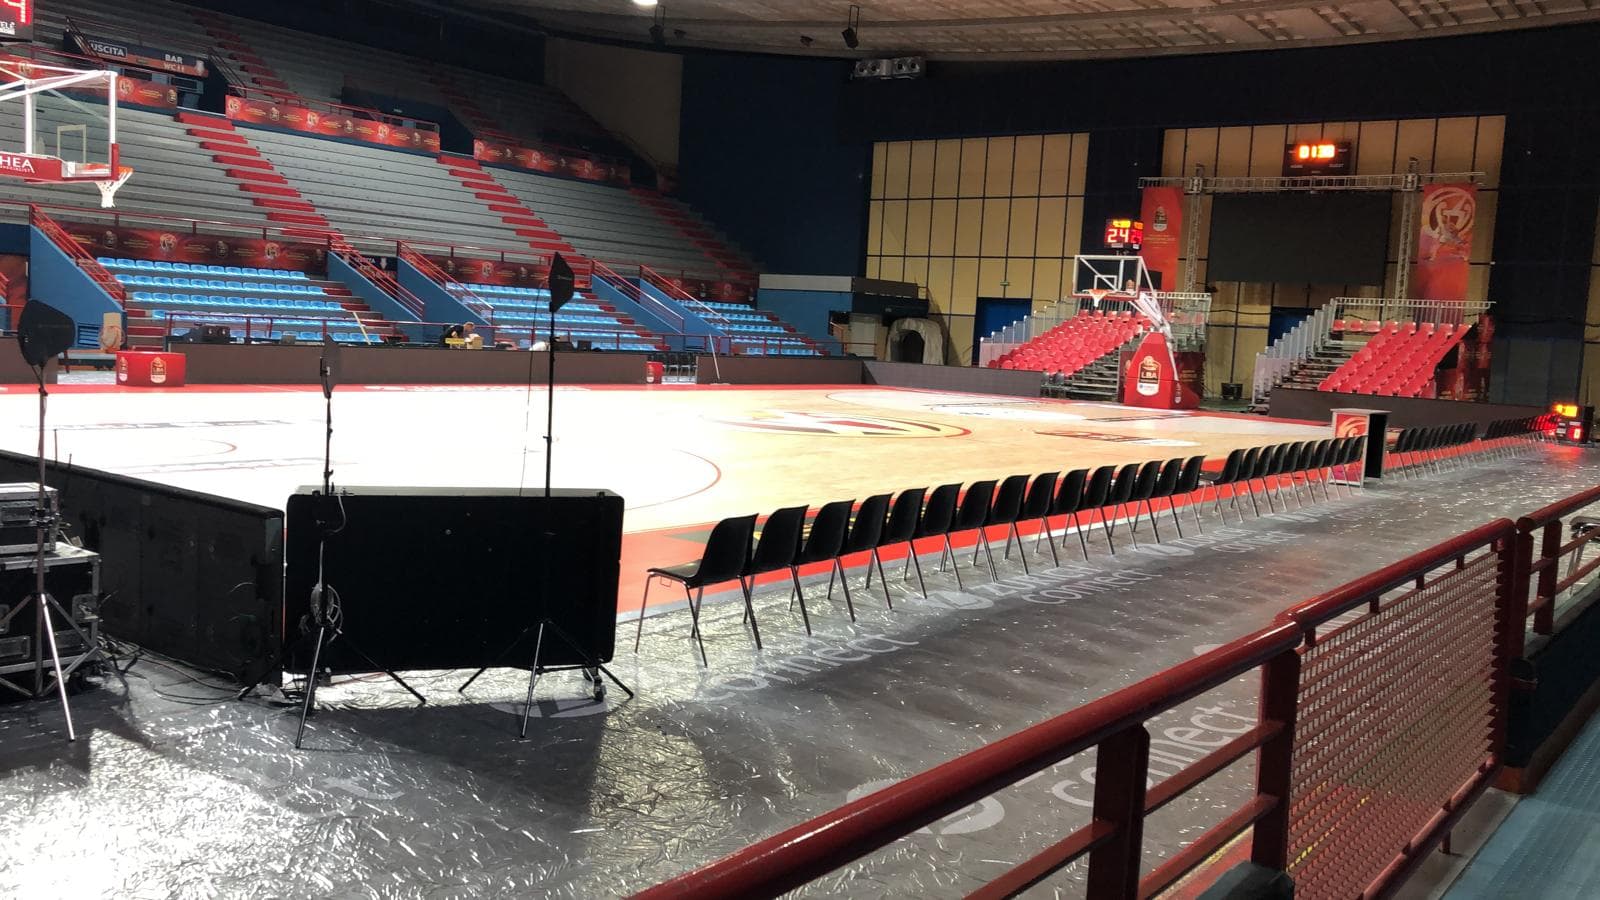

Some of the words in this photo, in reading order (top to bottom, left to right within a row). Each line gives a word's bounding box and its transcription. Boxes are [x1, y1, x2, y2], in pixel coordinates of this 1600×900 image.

[91, 43, 125, 56] USCITA
[164, 54, 183, 64] BAR
[1107, 229, 1130, 243] 24
[1141, 371, 1158, 379] LBA
[1021, 568, 1163, 604] connect
